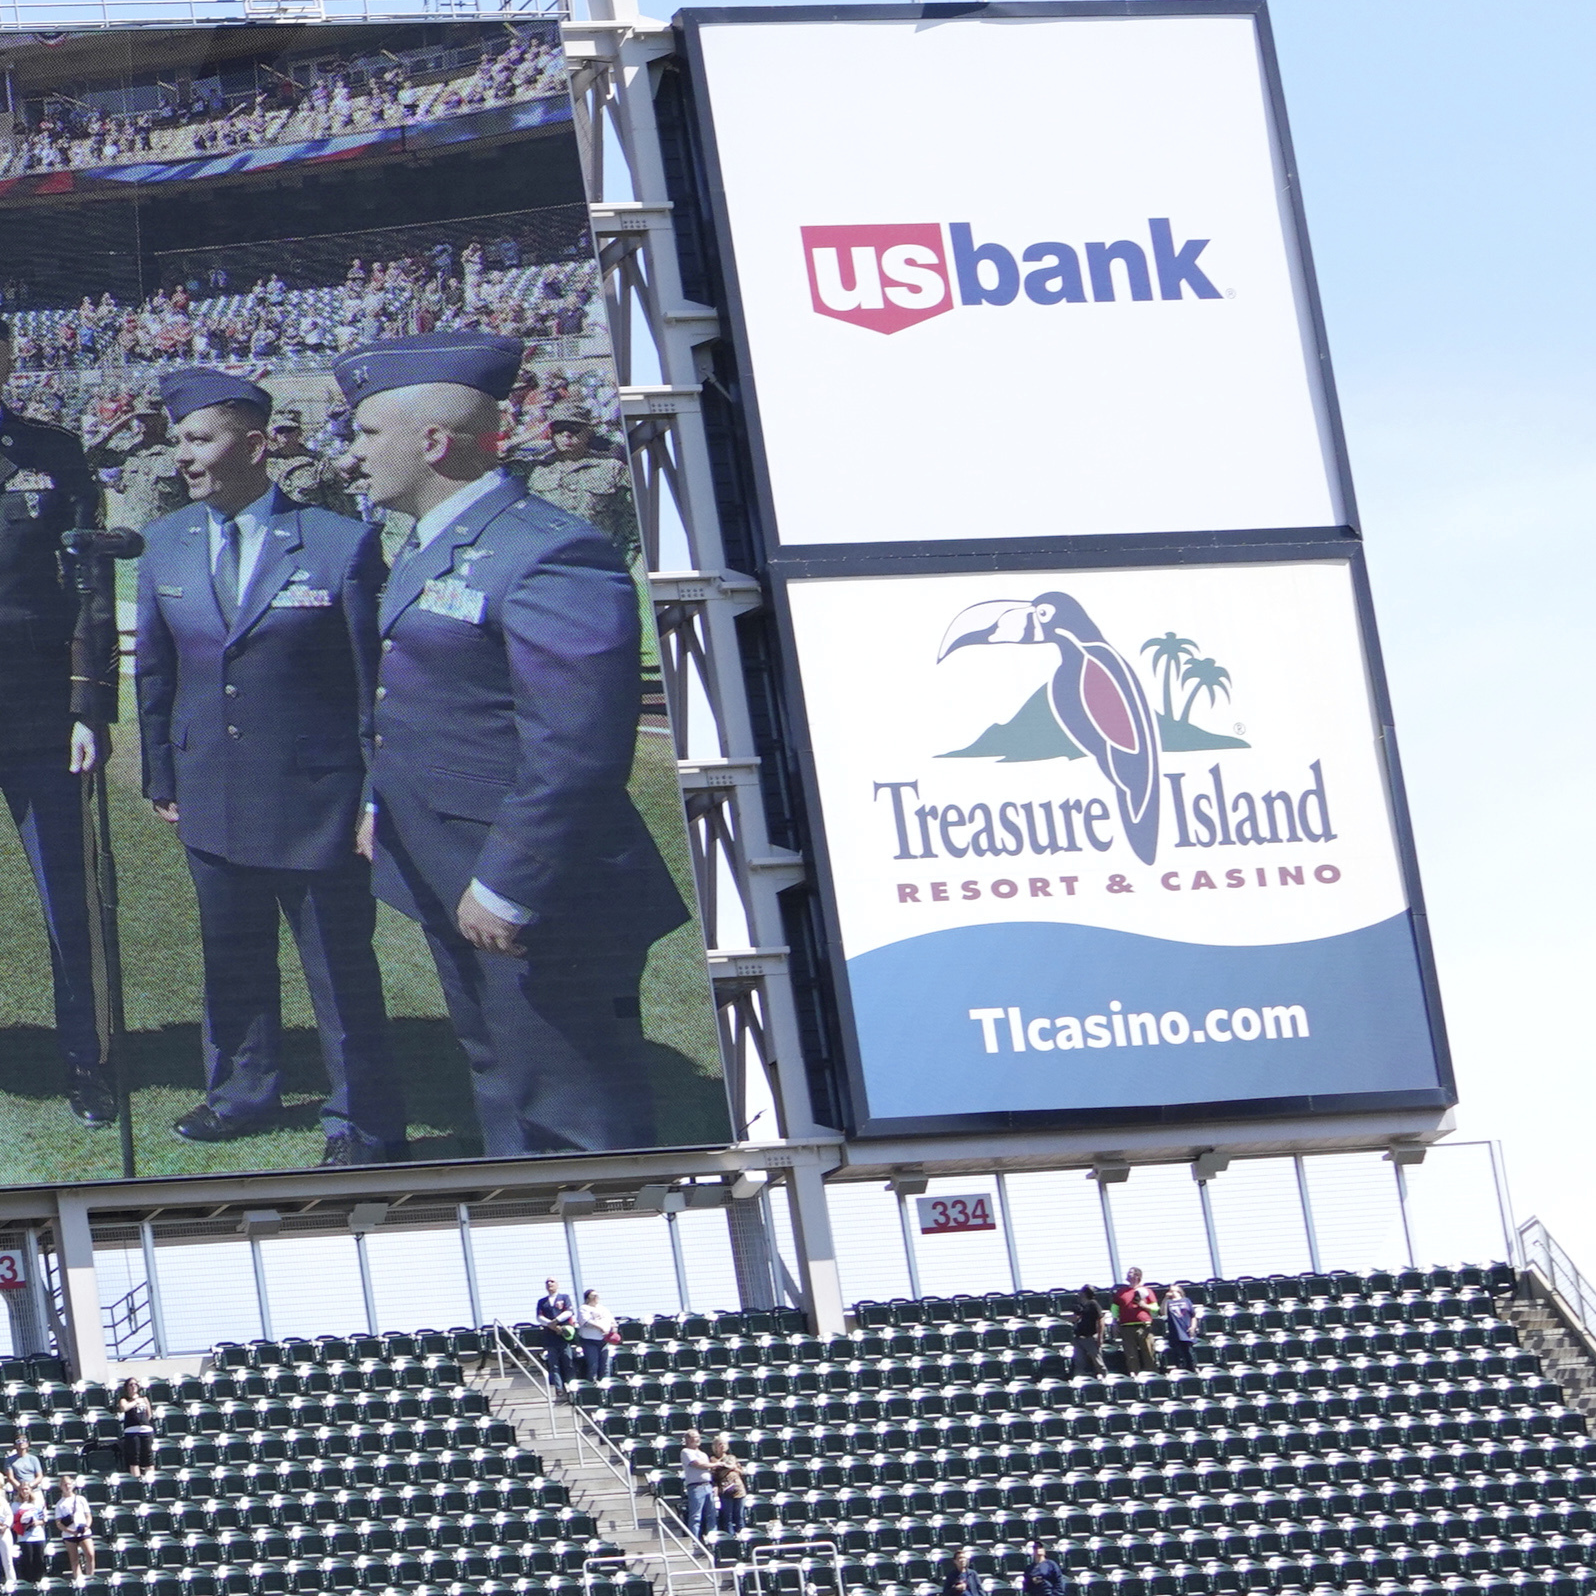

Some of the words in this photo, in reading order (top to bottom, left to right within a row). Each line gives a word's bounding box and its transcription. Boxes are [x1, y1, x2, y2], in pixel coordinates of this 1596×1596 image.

[872, 778, 1114, 861] Treasure
[1162, 758, 1337, 849] Island
[897, 875, 1079, 904] RESORT
[1105, 872, 1136, 895] &
[1161, 863, 1343, 892] CASINO
[968, 1000, 1310, 1055] TIcasino.com
[930, 1197, 991, 1228] 334
